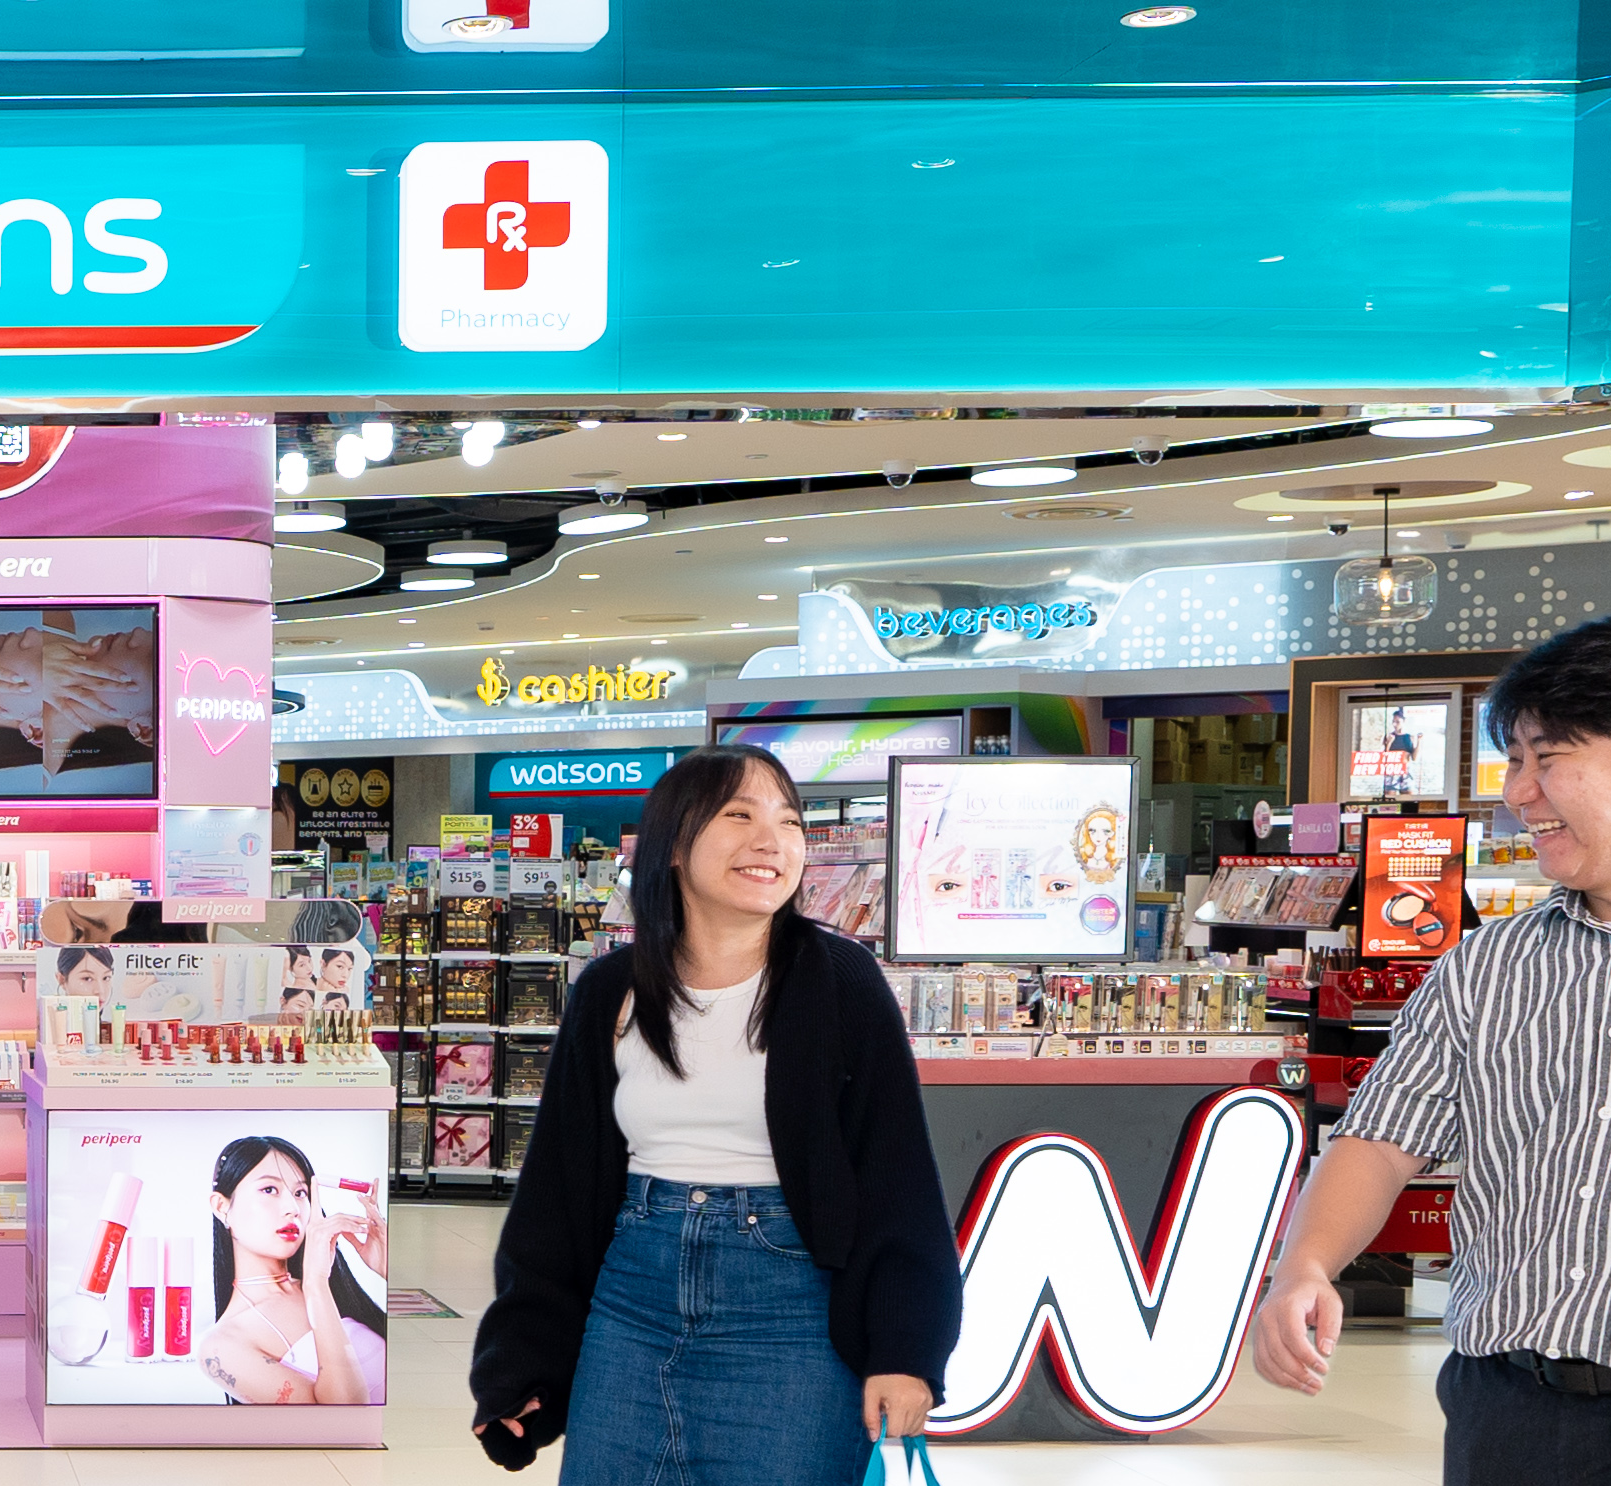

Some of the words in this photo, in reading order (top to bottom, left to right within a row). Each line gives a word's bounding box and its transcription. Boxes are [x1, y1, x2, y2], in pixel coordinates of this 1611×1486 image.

[437, 306, 571, 338] Pharmacy
[874, 605, 1092, 639] beverages
[518, 664, 671, 704] cashier
[176, 696, 267, 724] PERIPERA
[1354, 752, 1380, 762] FIND
[1383, 751, 1403, 762] THE
[510, 761, 642, 785] watsons
[1353, 763, 1379, 775] NEW
[513, 815, 539, 830] 3%
[1298, 824, 1321, 834] BANILA
[1323, 823, 1332, 832] CO
[1380, 839, 1402, 849] RED
[1403, 839, 1451, 849] CUSHION
[175, 901, 253, 919] peripera
[125, 953, 172, 969] Filter
[1281, 1069, 1305, 1084] W
[81, 1133, 142, 1147] peripera
